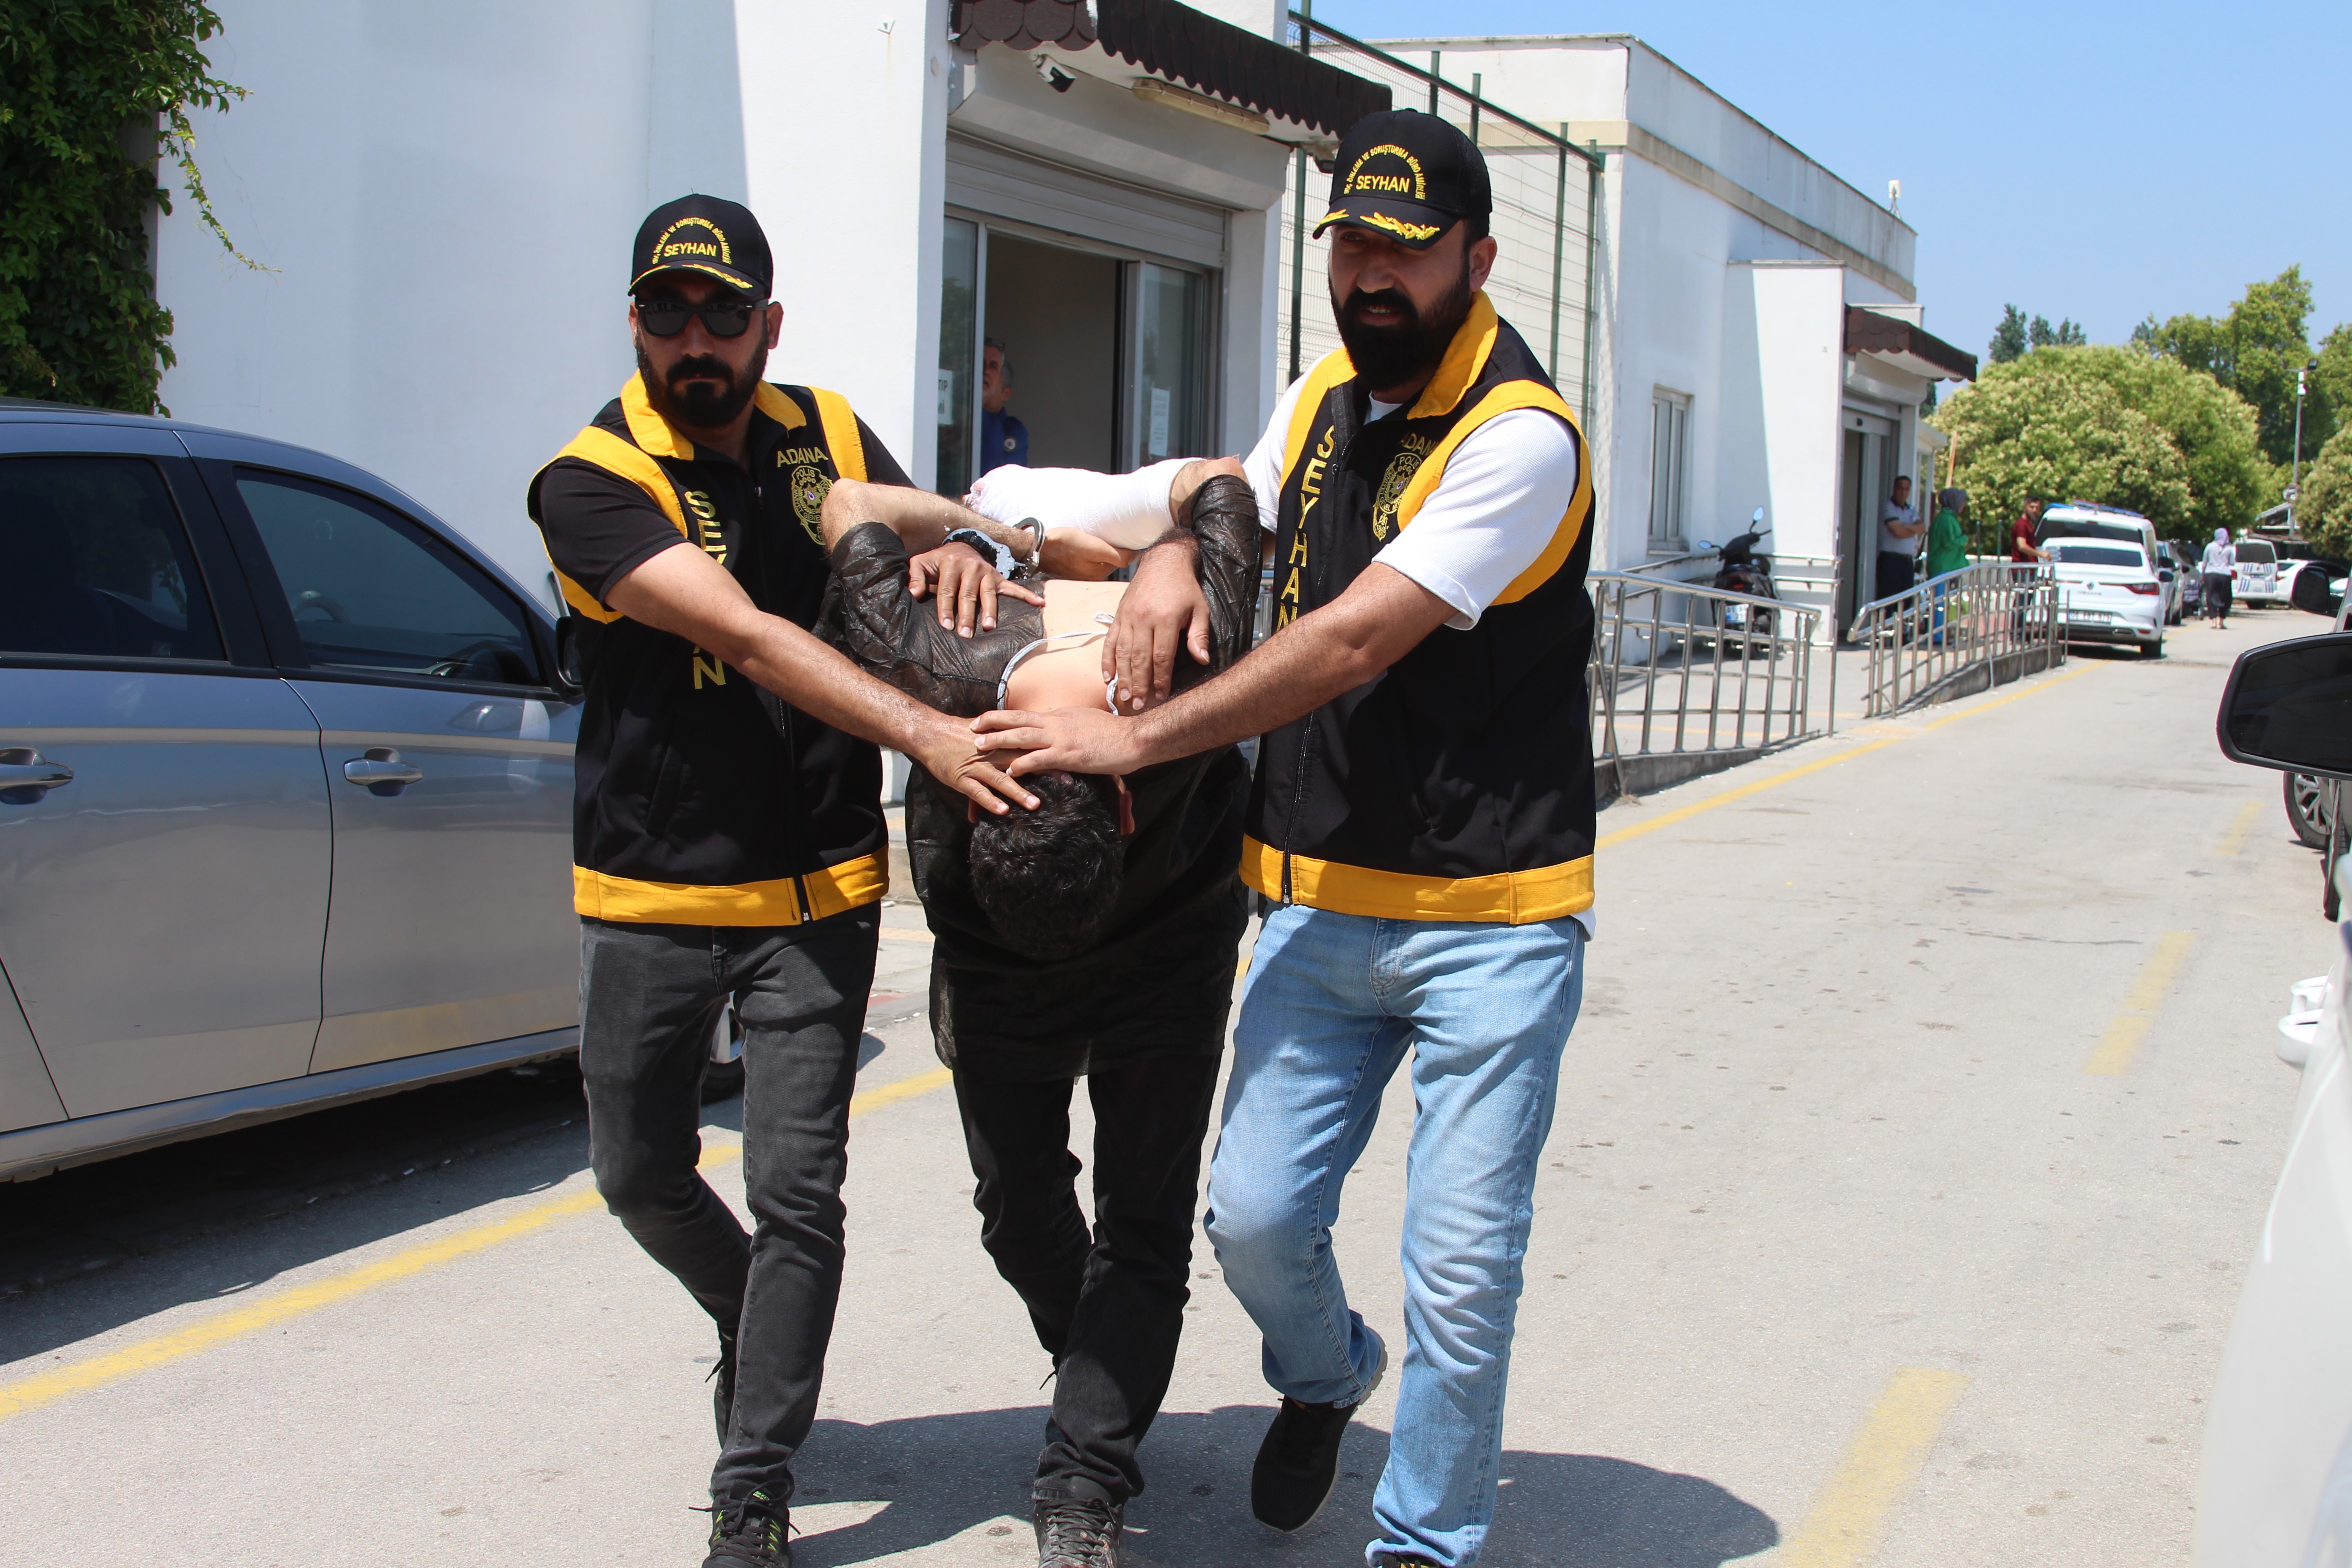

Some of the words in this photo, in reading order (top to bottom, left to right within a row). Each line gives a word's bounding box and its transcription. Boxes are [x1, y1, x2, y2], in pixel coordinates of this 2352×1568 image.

[1362, 152, 1370, 161] VE
[1370, 144, 1409, 160] SORUŞTURMA
[1406, 156, 1421, 173] BÜRO
[1356, 175, 1410, 193] SEYHAN
[667, 225, 677, 233] VE
[675, 217, 714, 230] SORUŞTURMA
[711, 227, 725, 241] BÜRO
[664, 242, 717, 257] SEYHAN
[1396, 431, 1439, 456] ADAN
[777, 447, 828, 468] ADANA
[804, 512, 821, 521] GENE
[1276, 425, 1335, 633] SEYHAN
[684, 491, 727, 690] SEN
